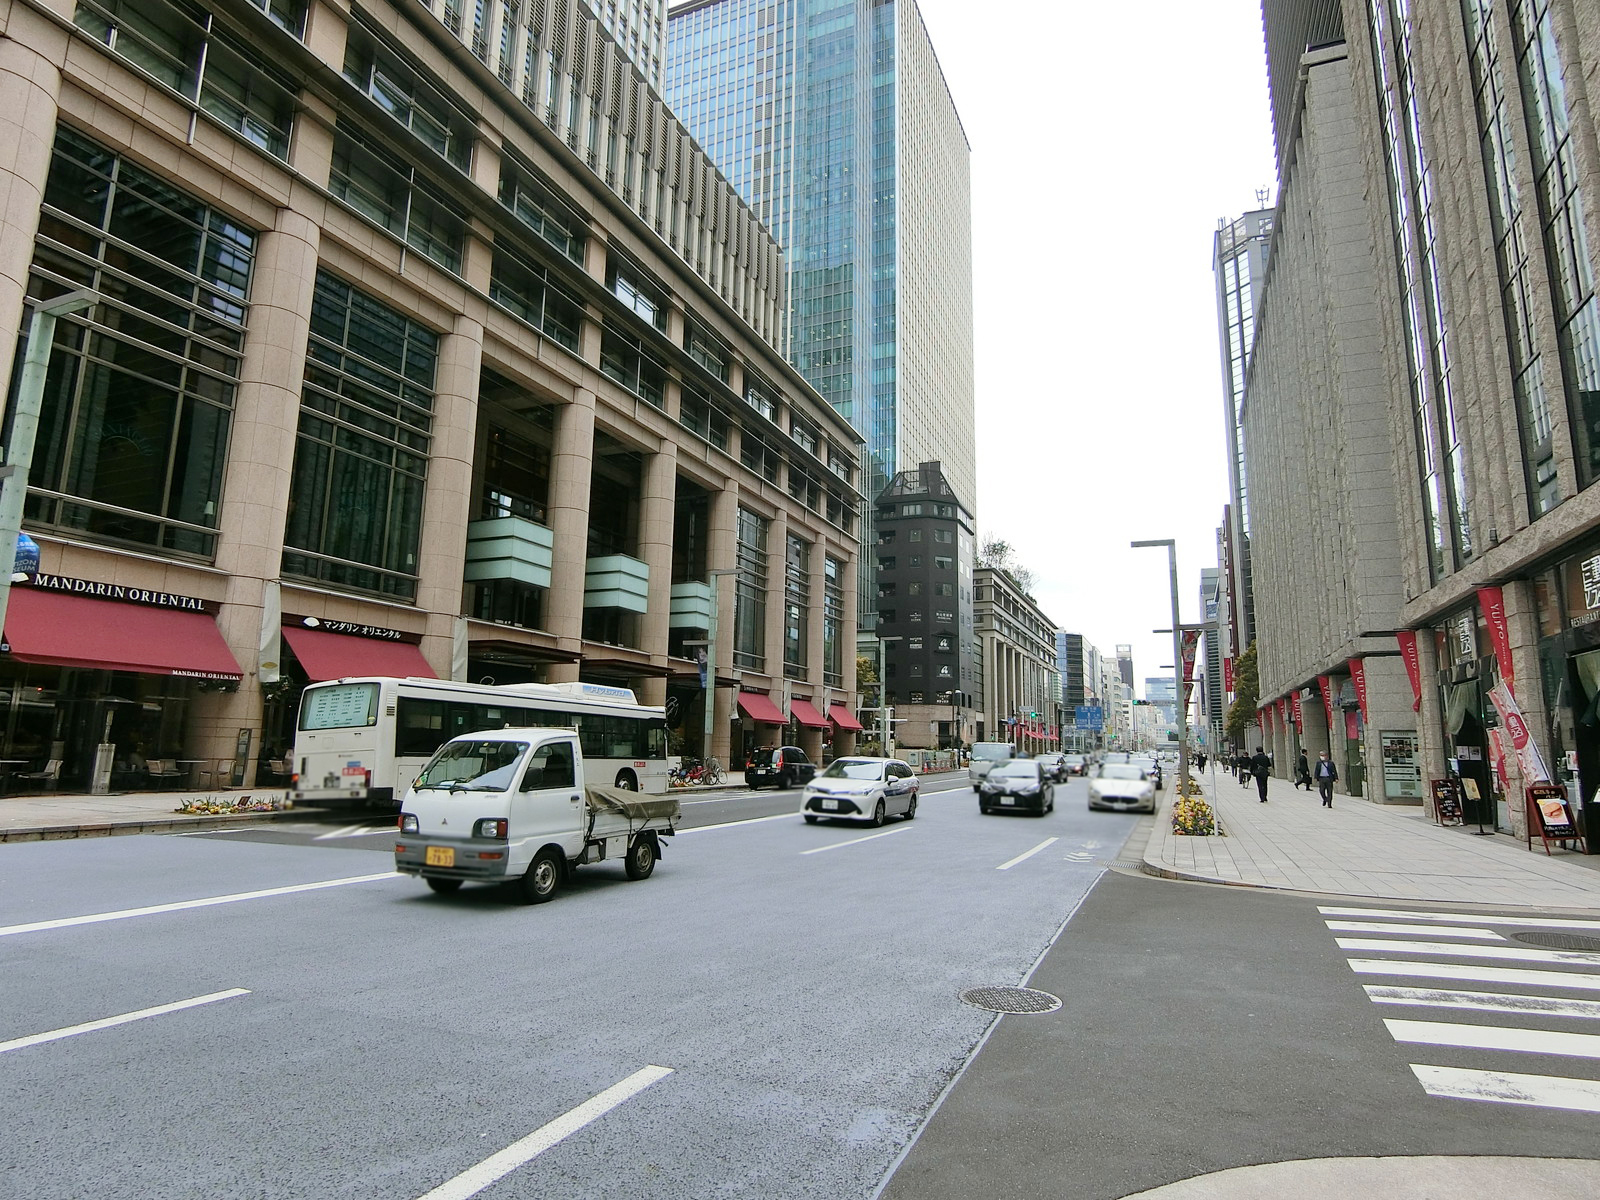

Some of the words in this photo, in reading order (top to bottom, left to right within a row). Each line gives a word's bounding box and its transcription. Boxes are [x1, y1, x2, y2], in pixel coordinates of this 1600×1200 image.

[34, 573, 125, 598] MANDARIN
[128, 589, 205, 610] ORIENTAL
[323, 620, 360, 633] マンダリン
[361, 625, 402, 639] オリエンタル
[1490, 603, 1504, 640] YUITO
[1406, 641, 1417, 669] YUITO
[172, 669, 207, 679] MANDARIN
[207, 672, 240, 681] ORIENTAL
[1355, 669, 1365, 702] YUITO
[589, 686, 626, 697] Hybrid
